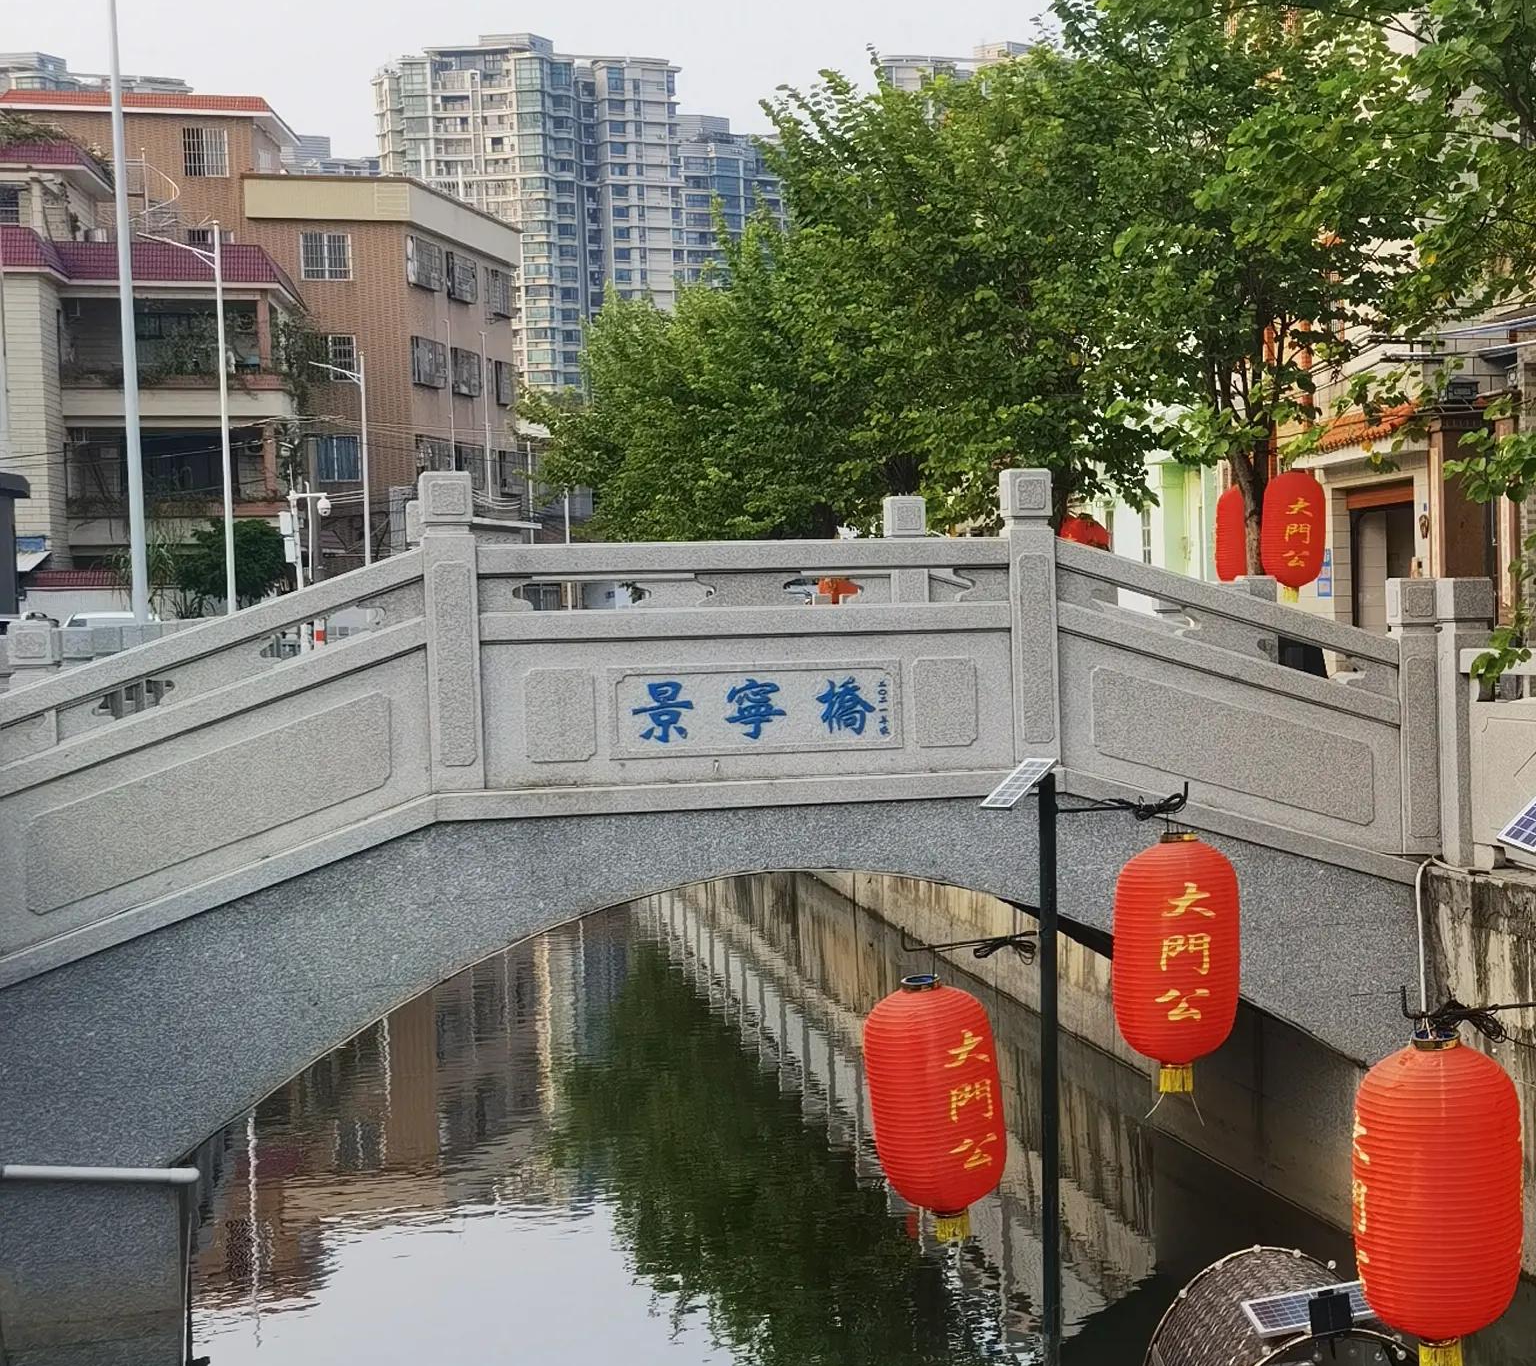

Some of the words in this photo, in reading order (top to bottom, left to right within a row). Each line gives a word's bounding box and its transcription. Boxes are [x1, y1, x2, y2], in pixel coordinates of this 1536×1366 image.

[1283, 497, 1313, 567] 大門公
[631, 677, 877, 743] 景寧橋
[1155, 882, 1216, 1022] 大門公
[944, 1029, 997, 1171] 大門公
